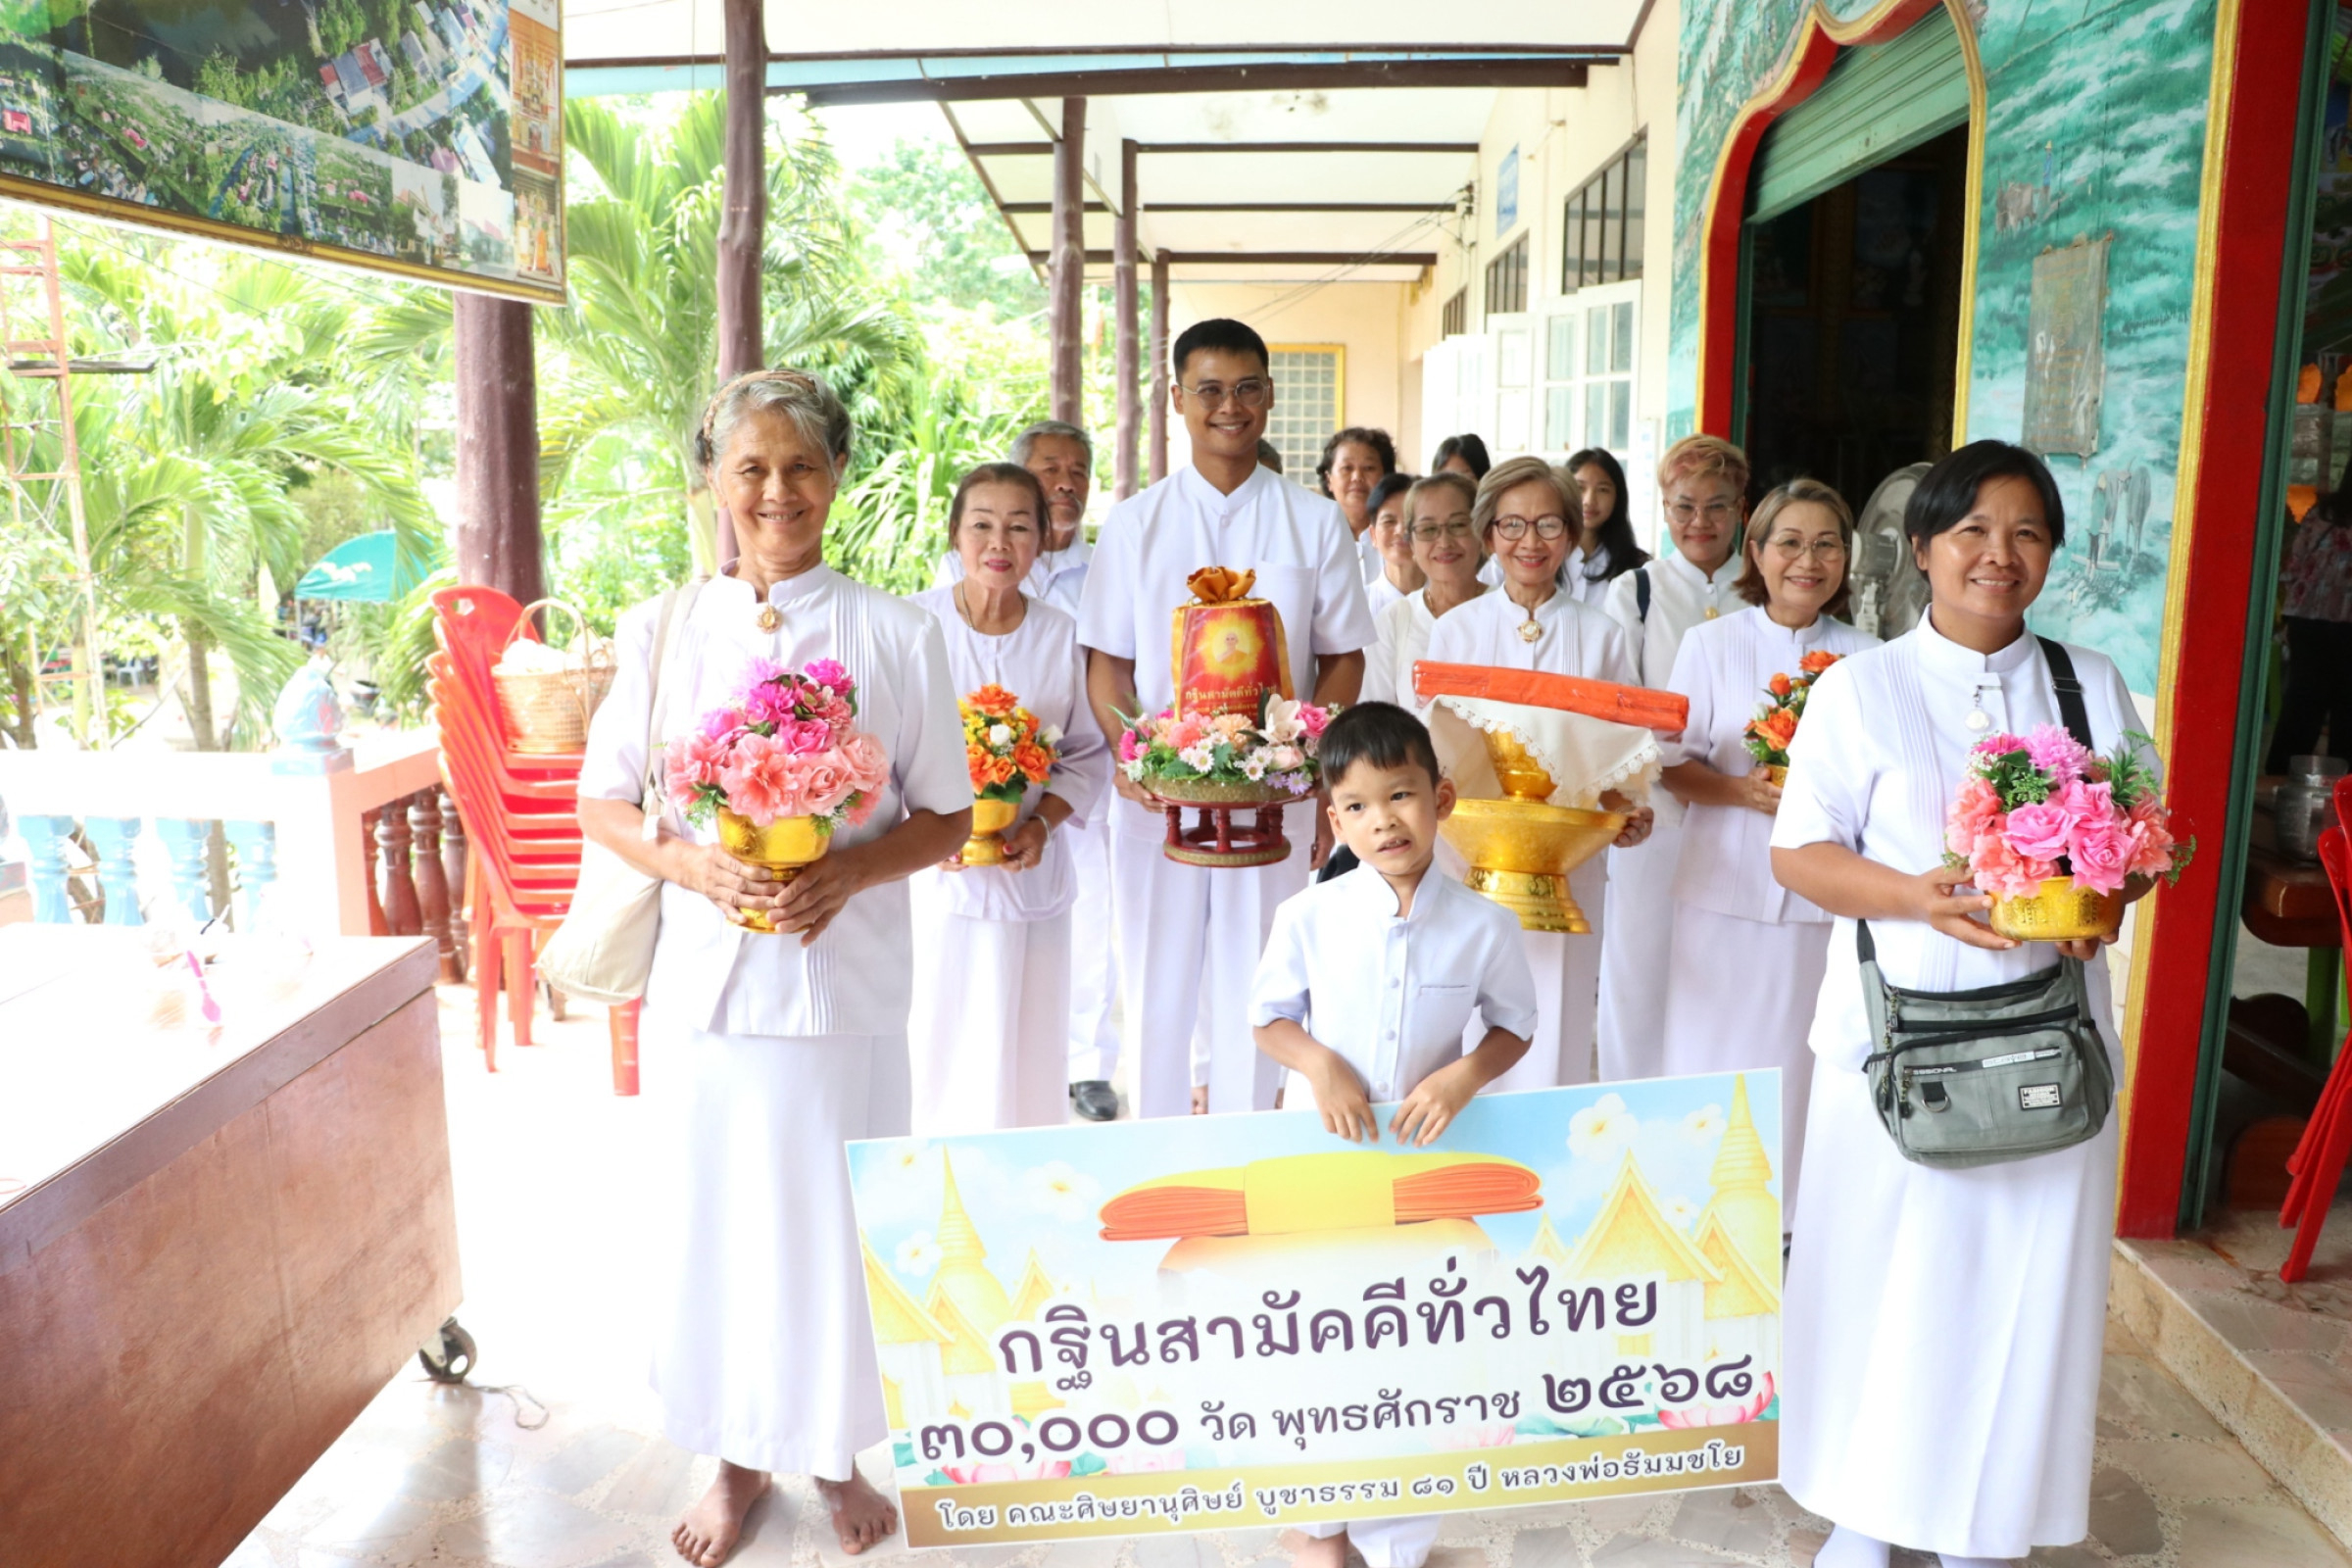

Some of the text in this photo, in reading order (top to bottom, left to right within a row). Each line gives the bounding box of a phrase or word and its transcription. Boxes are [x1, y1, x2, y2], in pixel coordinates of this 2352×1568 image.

[999, 1255, 1657, 1391] กฐินสามัคคีทั่วไทย
[920, 1354, 1752, 1463] ๓๐,๐๐๐ วัด พุทธศักราช ๒๕๖๘
[938, 1443, 1741, 1528] โดย คณะศิษยานุศิษย์ บูชาธรรม ๘๑ ปี หลวงพ่อธัมมชโย
